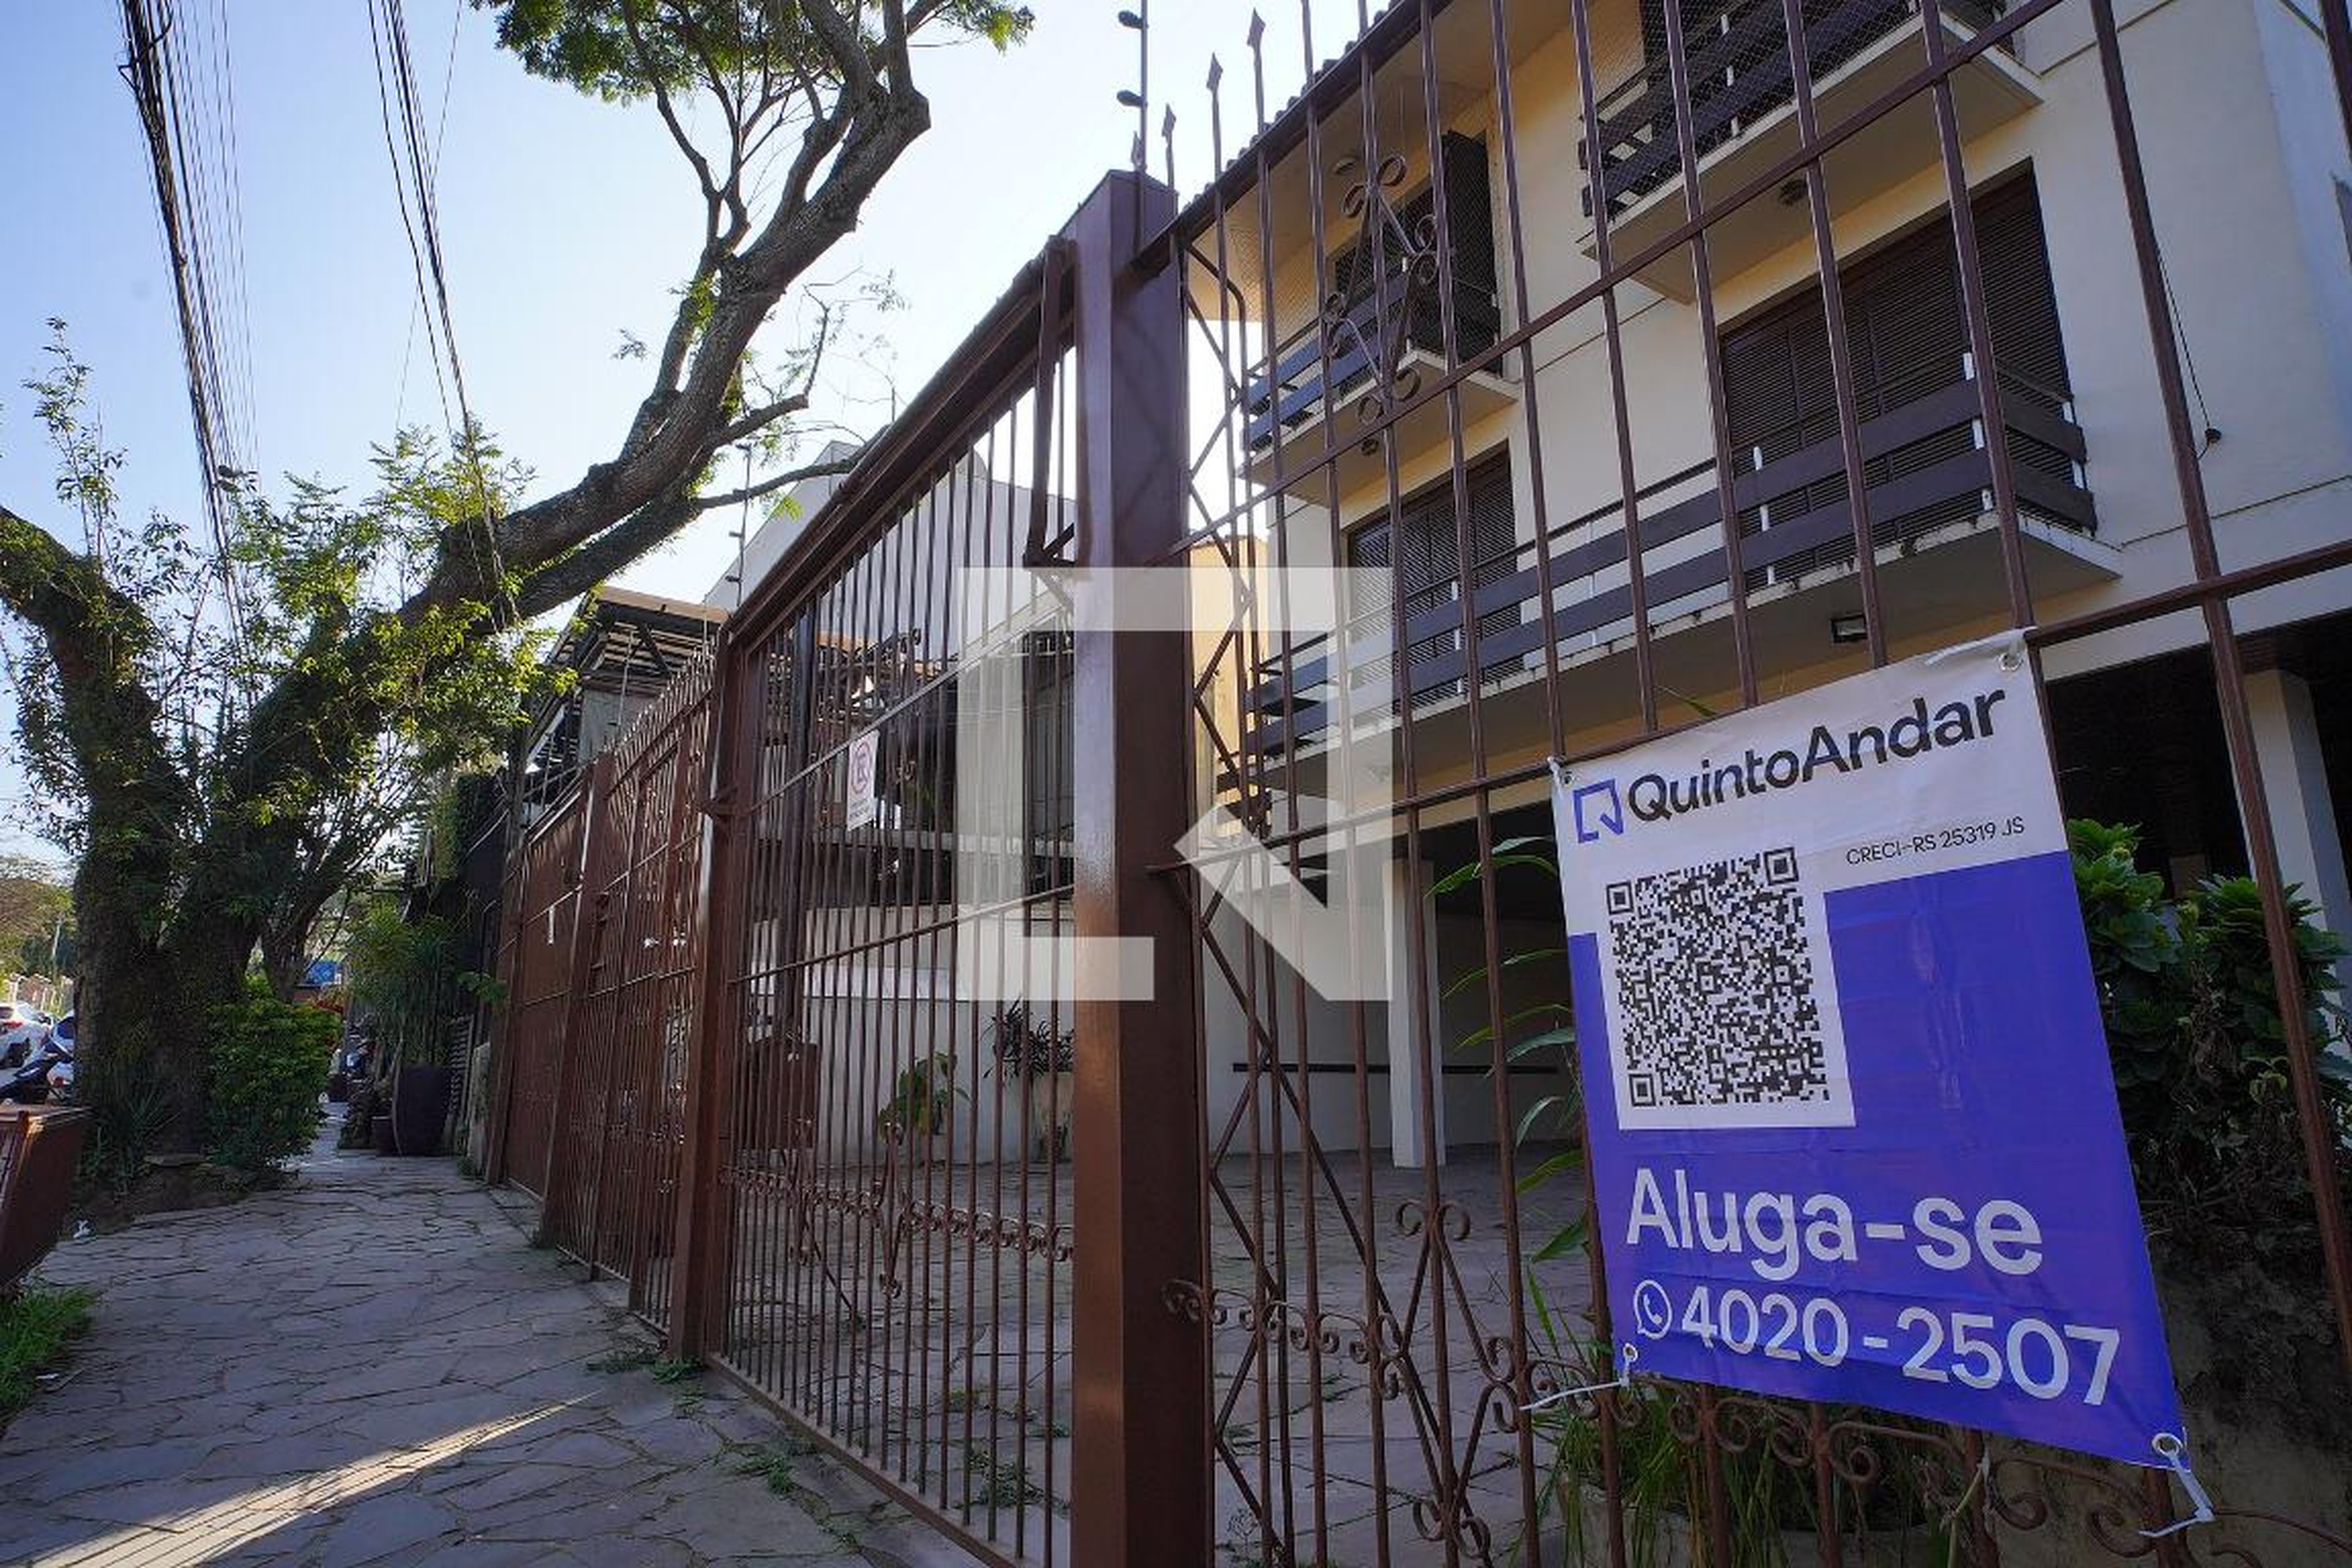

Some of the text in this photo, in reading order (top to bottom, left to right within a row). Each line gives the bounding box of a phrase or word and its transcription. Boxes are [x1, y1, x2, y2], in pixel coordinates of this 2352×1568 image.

[1627, 688, 2006, 822] QuintoAndar
[1846, 816, 2025, 865] CRECI-RS 25319 JS
[1626, 1168, 2043, 1281] Aluga-se
